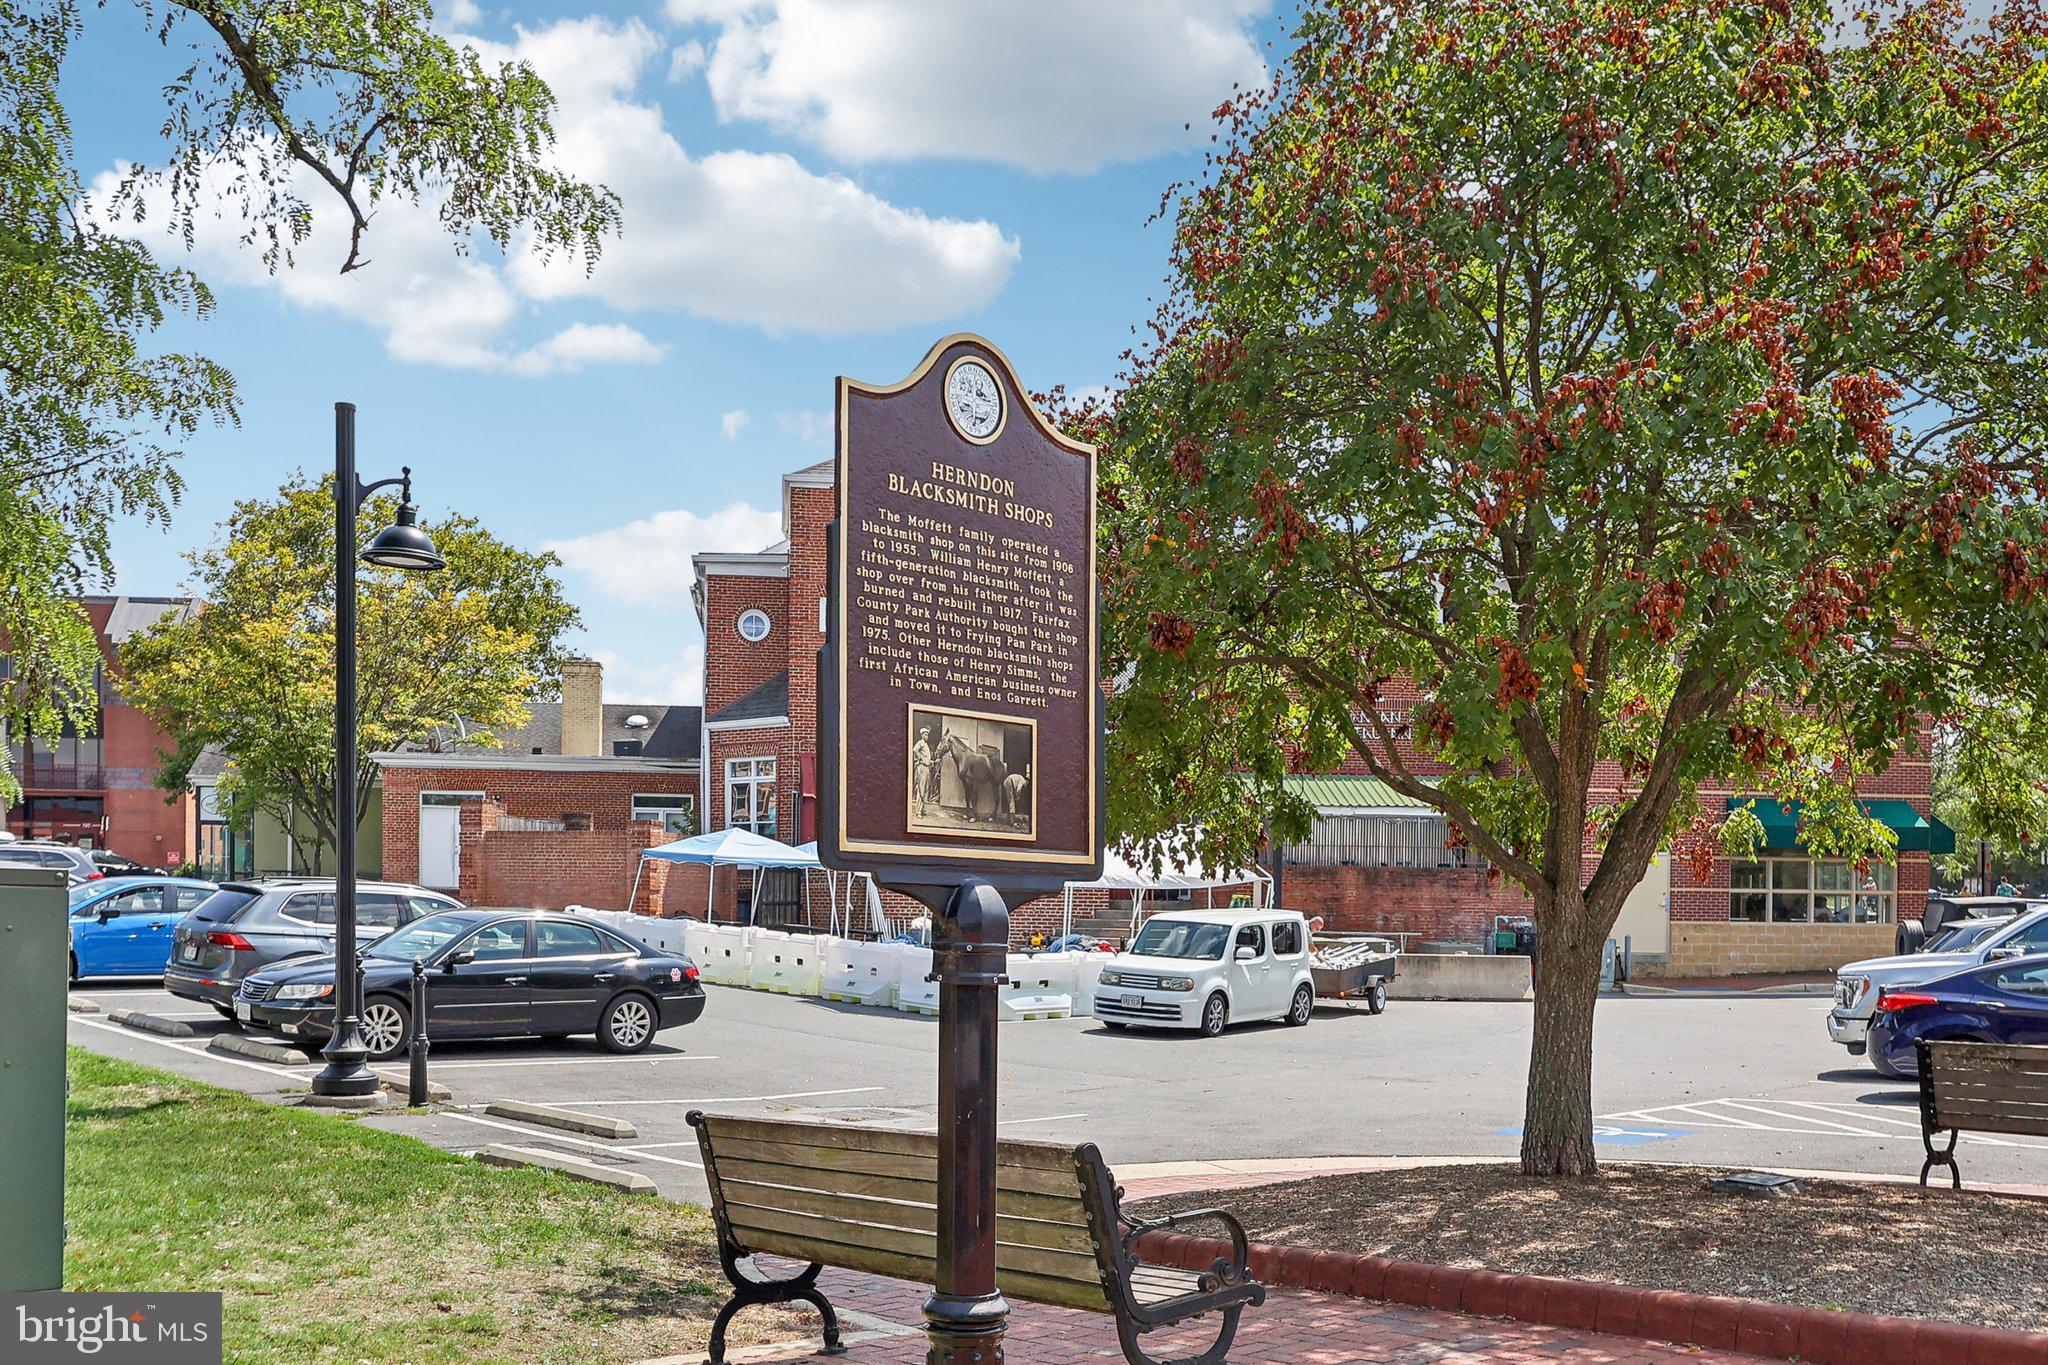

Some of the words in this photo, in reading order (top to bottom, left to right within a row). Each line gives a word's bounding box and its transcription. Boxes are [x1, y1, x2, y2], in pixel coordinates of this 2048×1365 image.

[888, 473, 999, 516] BLACKSMITH
[1004, 502, 1053, 528] SHOPS
[931, 461, 1015, 498] HERNDON
[862, 520, 924, 543] blacksmith
[930, 536, 954, 550] shop
[959, 543, 970, 552] on
[976, 545, 996, 557] this
[1000, 550, 1019, 562] site
[1025, 555, 1047, 568] from
[1053, 560, 1073, 573] 1906
[879, 508, 900, 522] The
[908, 515, 951, 533] Moffett
[959, 526, 994, 544] family
[1002, 538, 1048, 555] operated
[862, 550, 956, 579] fifth-generation
[963, 571, 1022, 592] blacksmith,
[1030, 585, 1051, 598] took
[1058, 590, 1073, 602] the
[873, 538, 884, 549] to
[891, 541, 920, 556] 1955.
[930, 549, 971, 567] William
[977, 558, 1008, 576] Henry
[1014, 566, 1054, 585] Moffett,
[1059, 578, 1064, 586] a
[857, 566, 882, 581] shop
[889, 574, 914, 585] over
[921, 578, 946, 592] from
[953, 584, 968, 595] his
[975, 588, 1008, 602] father
[1014, 596, 1039, 609] after
[1046, 601, 1053, 611] it
[1059, 606, 1076, 616] was
[864, 581, 904, 598] burned
[913, 592, 932, 603] and
[939, 597, 976, 611] rebuilt
[982, 603, 992, 614] in
[1000, 606, 1022, 620] 1917.
[1032, 612, 1070, 628] Fairfax
[857, 596, 898, 613] County
[905, 604, 930, 618] Park
[935, 610, 988, 629] Authority
[993, 620, 1027, 636] bought
[1034, 627, 1050, 638] the
[1056, 632, 1077, 646] shop
[869, 615, 888, 626] and
[895, 619, 930, 632] moved
[937, 624, 945, 634] it
[951, 627, 961, 637] to
[967, 629, 1000, 647] Frying
[1007, 636, 1025, 648] Pan
[1031, 640, 1053, 653] Park
[1058, 644, 1067, 656] in
[863, 626, 890, 640] 1975.
[899, 632, 931, 647] Other
[938, 638, 982, 656] Herndon
[987, 647, 1042, 666] blacksmith
[1047, 658, 1073, 671] shops
[869, 642, 911, 659] include
[918, 651, 948, 664] those
[954, 657, 964, 667] of
[970, 659, 1002, 674] Henry
[1008, 665, 1040, 680] Simms,
[1051, 672, 1066, 683] the
[860, 657, 886, 670] first
[894, 662, 938, 678] African
[946, 670, 996, 686] American
[1002, 678, 1044, 693] business
[1048, 687, 1076, 698] owner
[890, 676, 901, 687] in
[909, 678, 941, 694] Town,
[952, 686, 970, 697] and
[977, 688, 1001, 701] Enos
[1007, 693, 1048, 707] Garrett.
